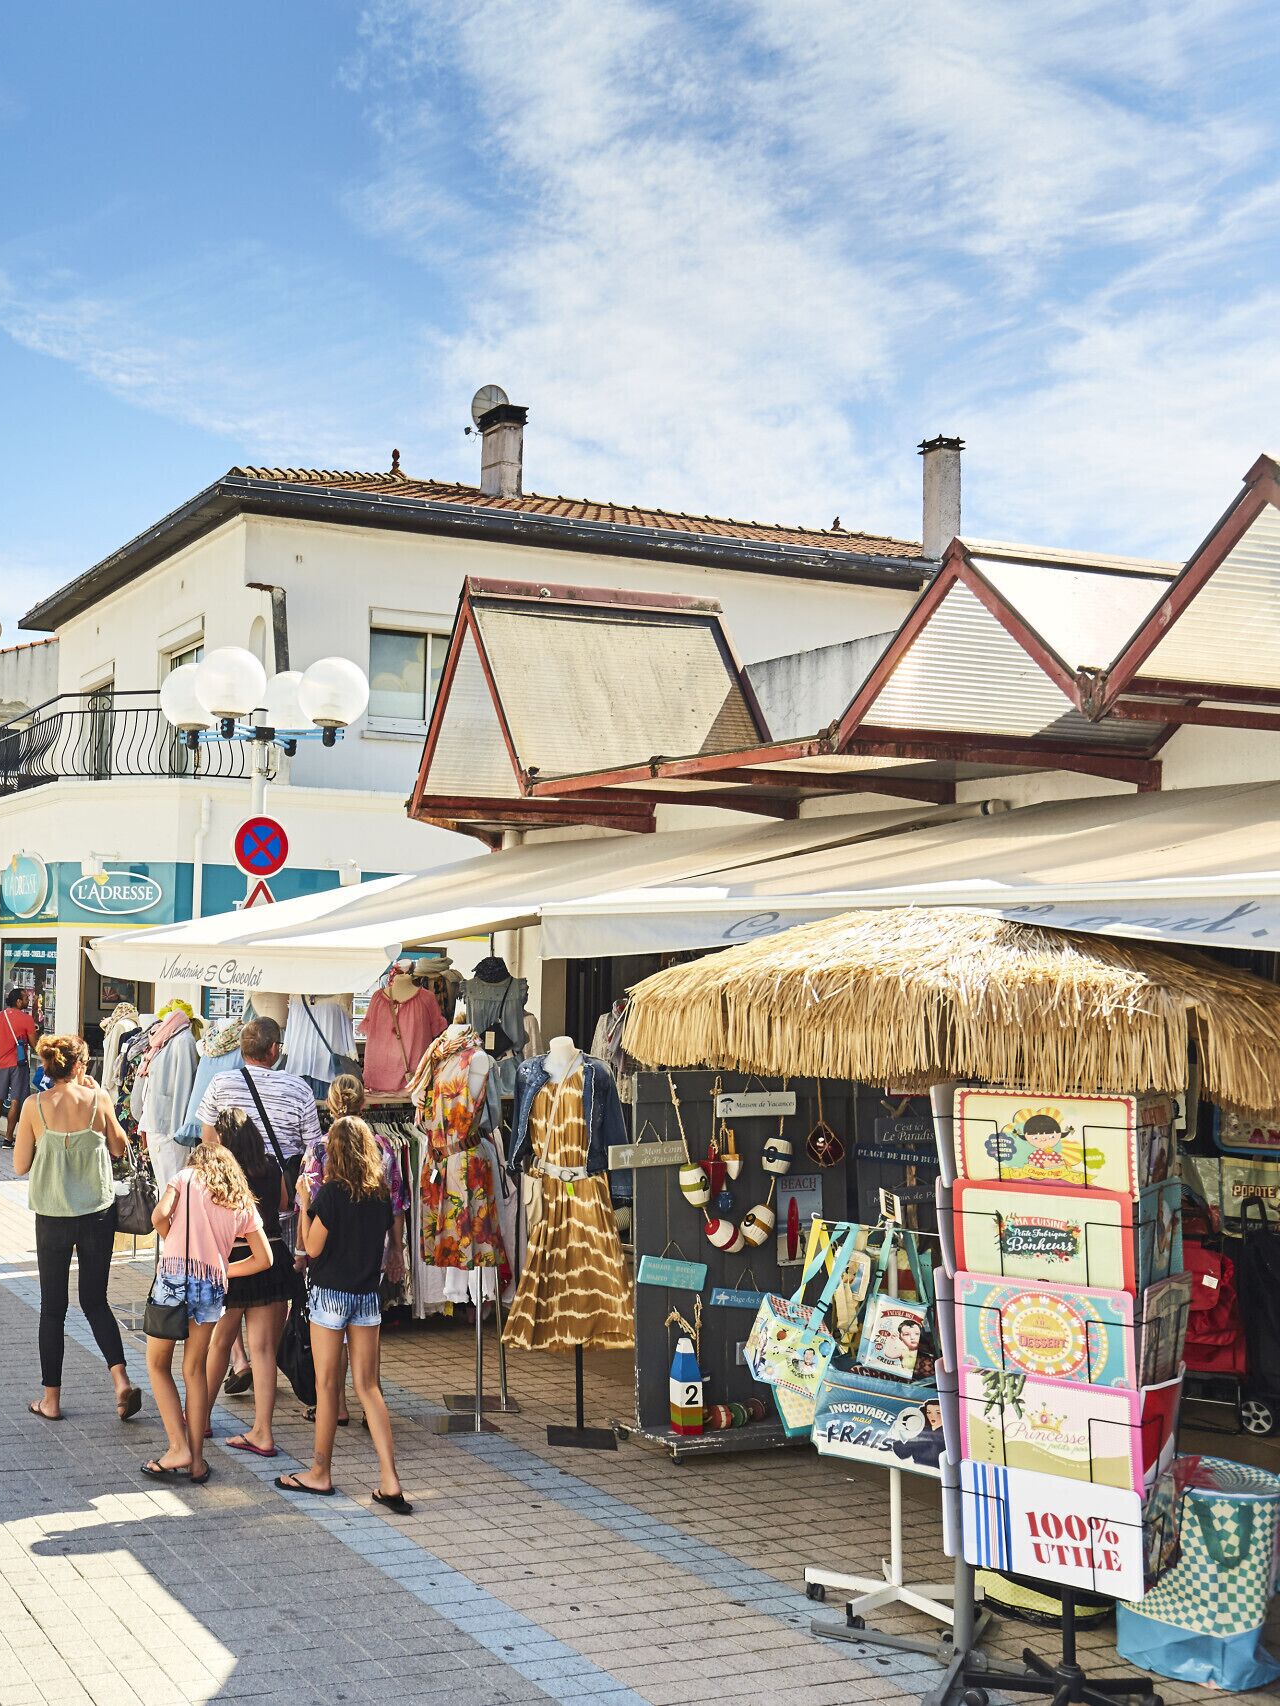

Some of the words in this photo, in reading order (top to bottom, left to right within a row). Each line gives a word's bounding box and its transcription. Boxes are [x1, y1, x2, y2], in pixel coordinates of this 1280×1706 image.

[78, 882, 154, 911] L'ADRESSE
[204, 965, 218, 982] &
[219, 959, 263, 987] Chocolat
[767, 1100, 795, 1108] Vacances
[882, 1132, 896, 1141] Le
[897, 1131, 935, 1141] Paradis
[857, 1149, 886, 1159] PLAGE
[887, 1152, 899, 1160] DE
[780, 1178, 817, 1190] BEACH
[1232, 1185, 1277, 1198] POPOTE
[1015, 1217, 1029, 1226] MA
[1031, 1218, 1065, 1229] CUISINE
[1012, 1228, 1032, 1237] Petite
[1032, 1229, 1067, 1240] Fabrique
[1006, 1236, 1075, 1252] Bonheurs
[685, 1384, 699, 1405] 2
[828, 1403, 896, 1426] INCROYABLE
[851, 1415, 873, 1424] mais
[825, 1419, 897, 1452] FRAIS
[1004, 1421, 1086, 1444] Princesse
[1025, 1511, 1120, 1545] 100%
[1031, 1542, 1122, 1572] UTILE
